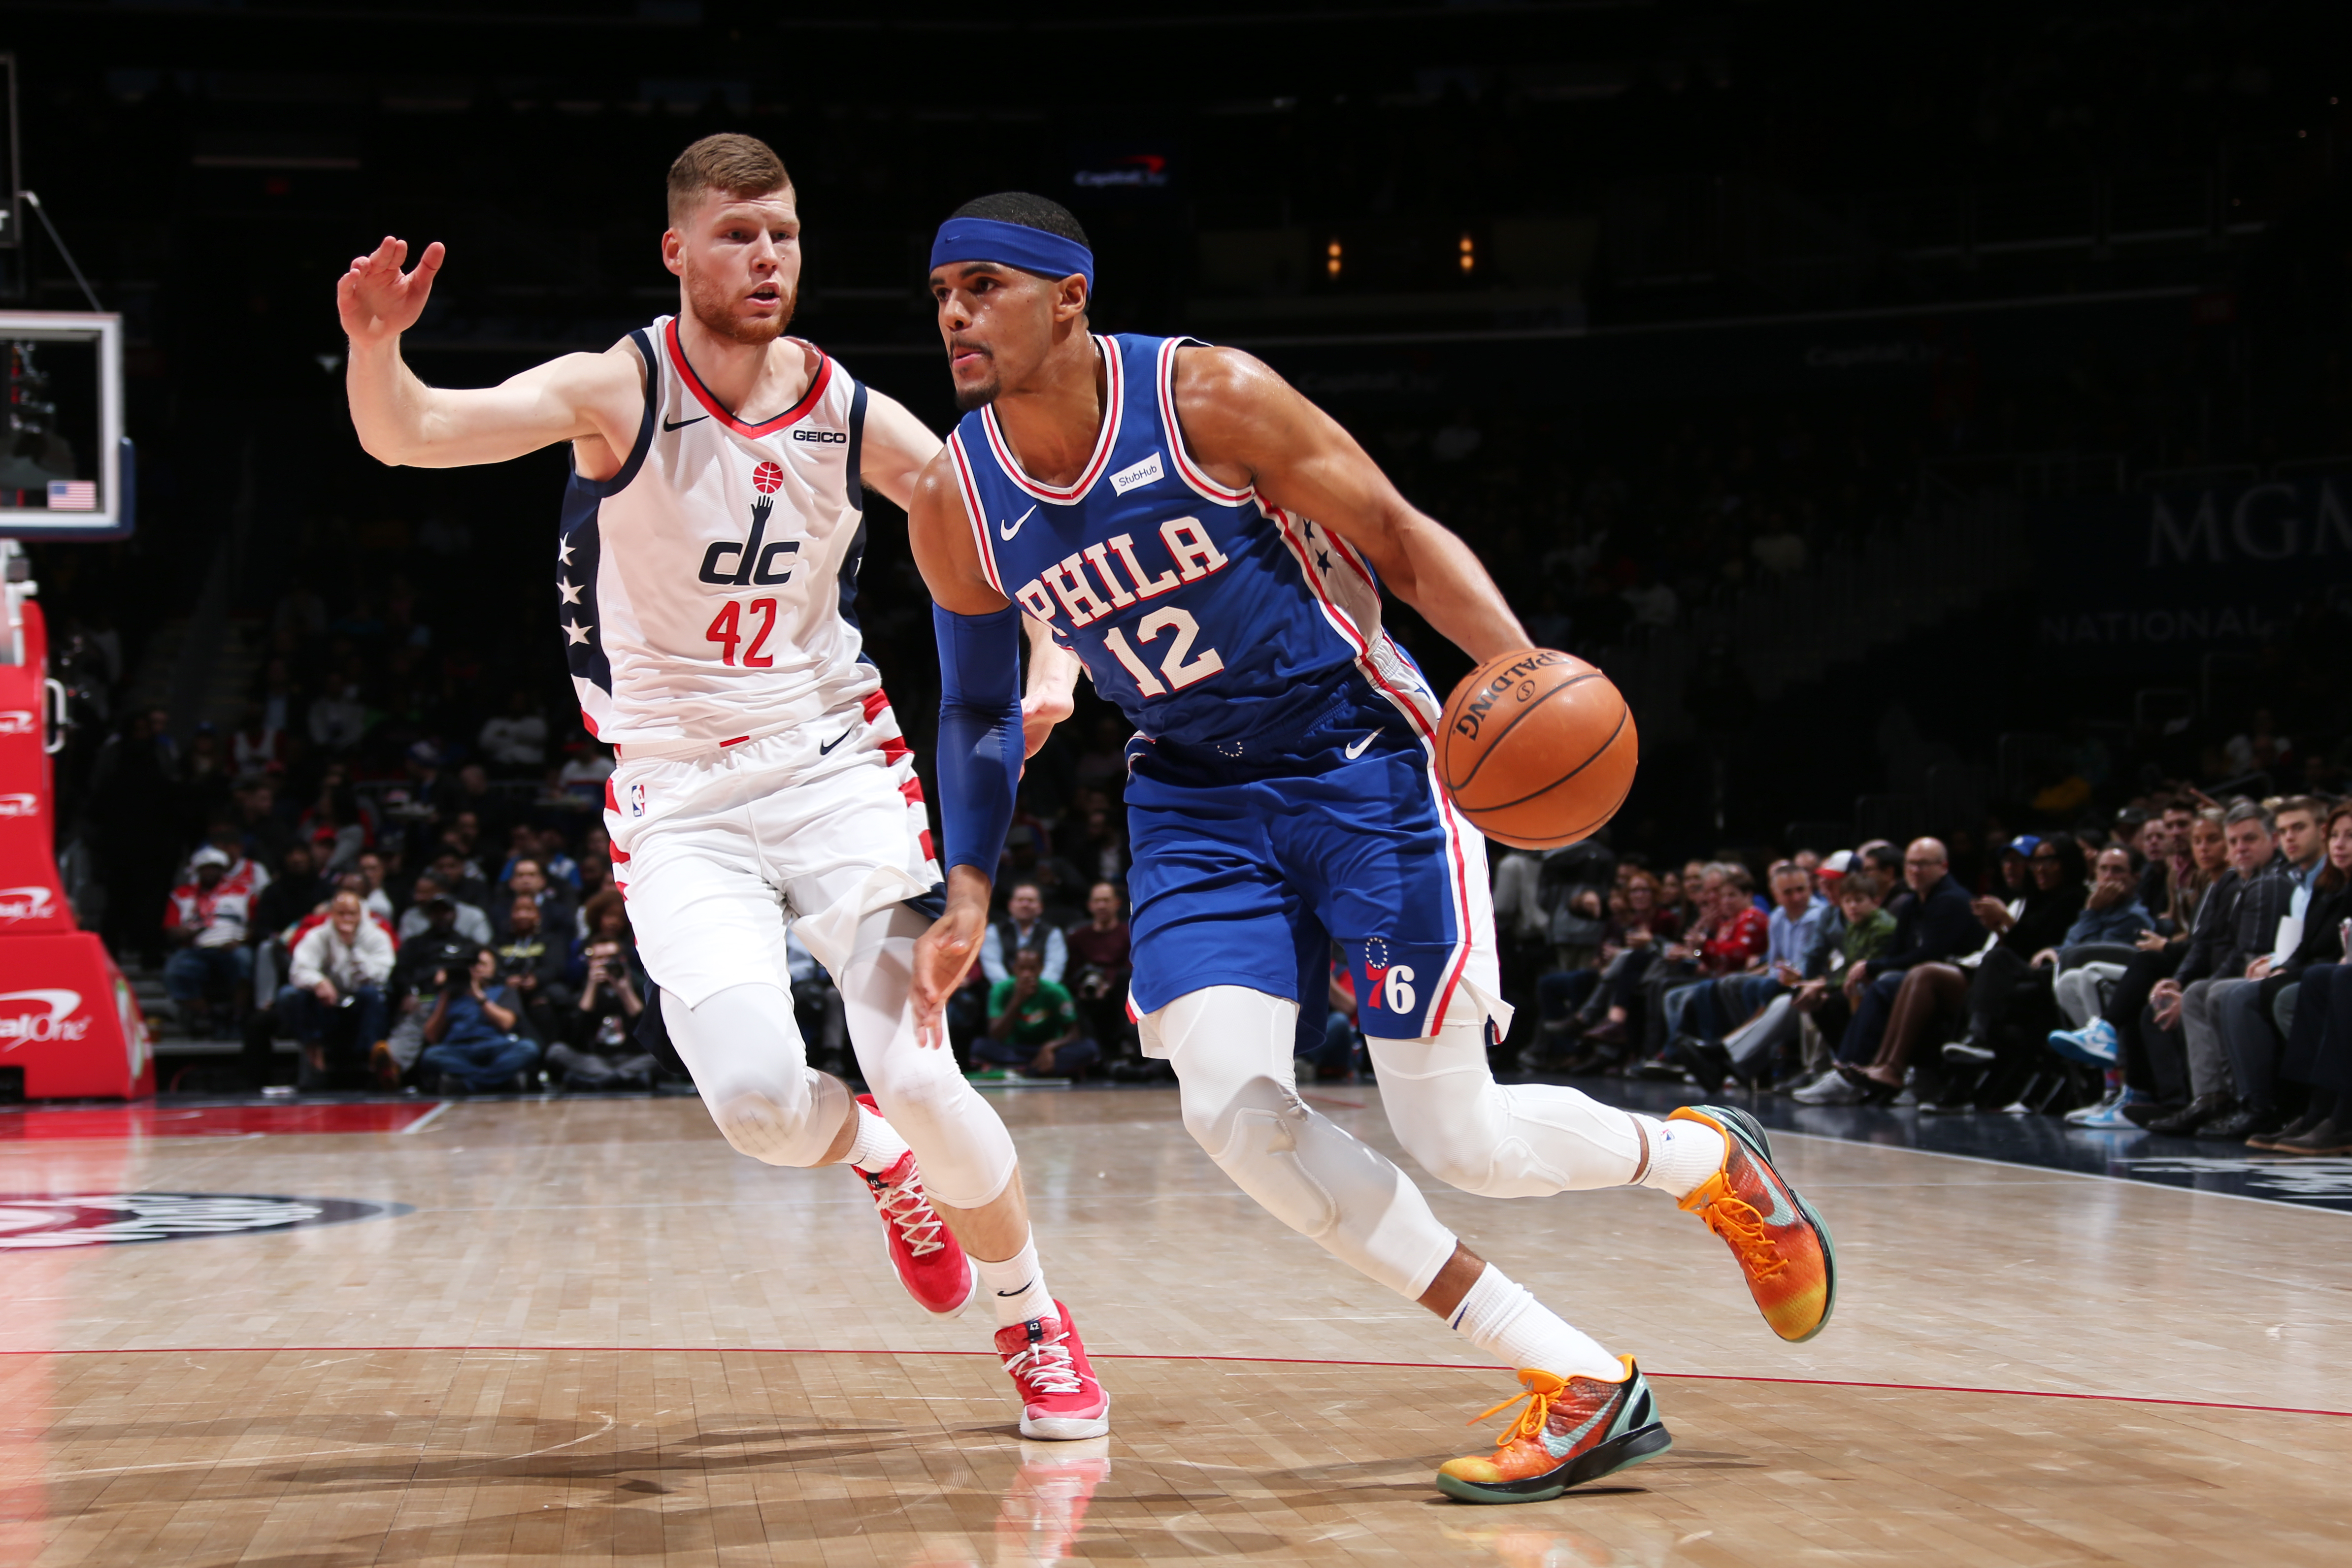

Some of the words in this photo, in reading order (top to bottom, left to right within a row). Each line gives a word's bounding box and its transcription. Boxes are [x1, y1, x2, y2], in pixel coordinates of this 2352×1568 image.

[793, 430, 846, 444] GEICO
[1119, 465, 1157, 487] StubHub
[1015, 516, 1228, 637] PHILA
[706, 598, 777, 667] 42
[2042, 605, 2269, 643] NATIONAL
[1103, 606, 1225, 699] 12
[1365, 961, 1416, 1014] 76
